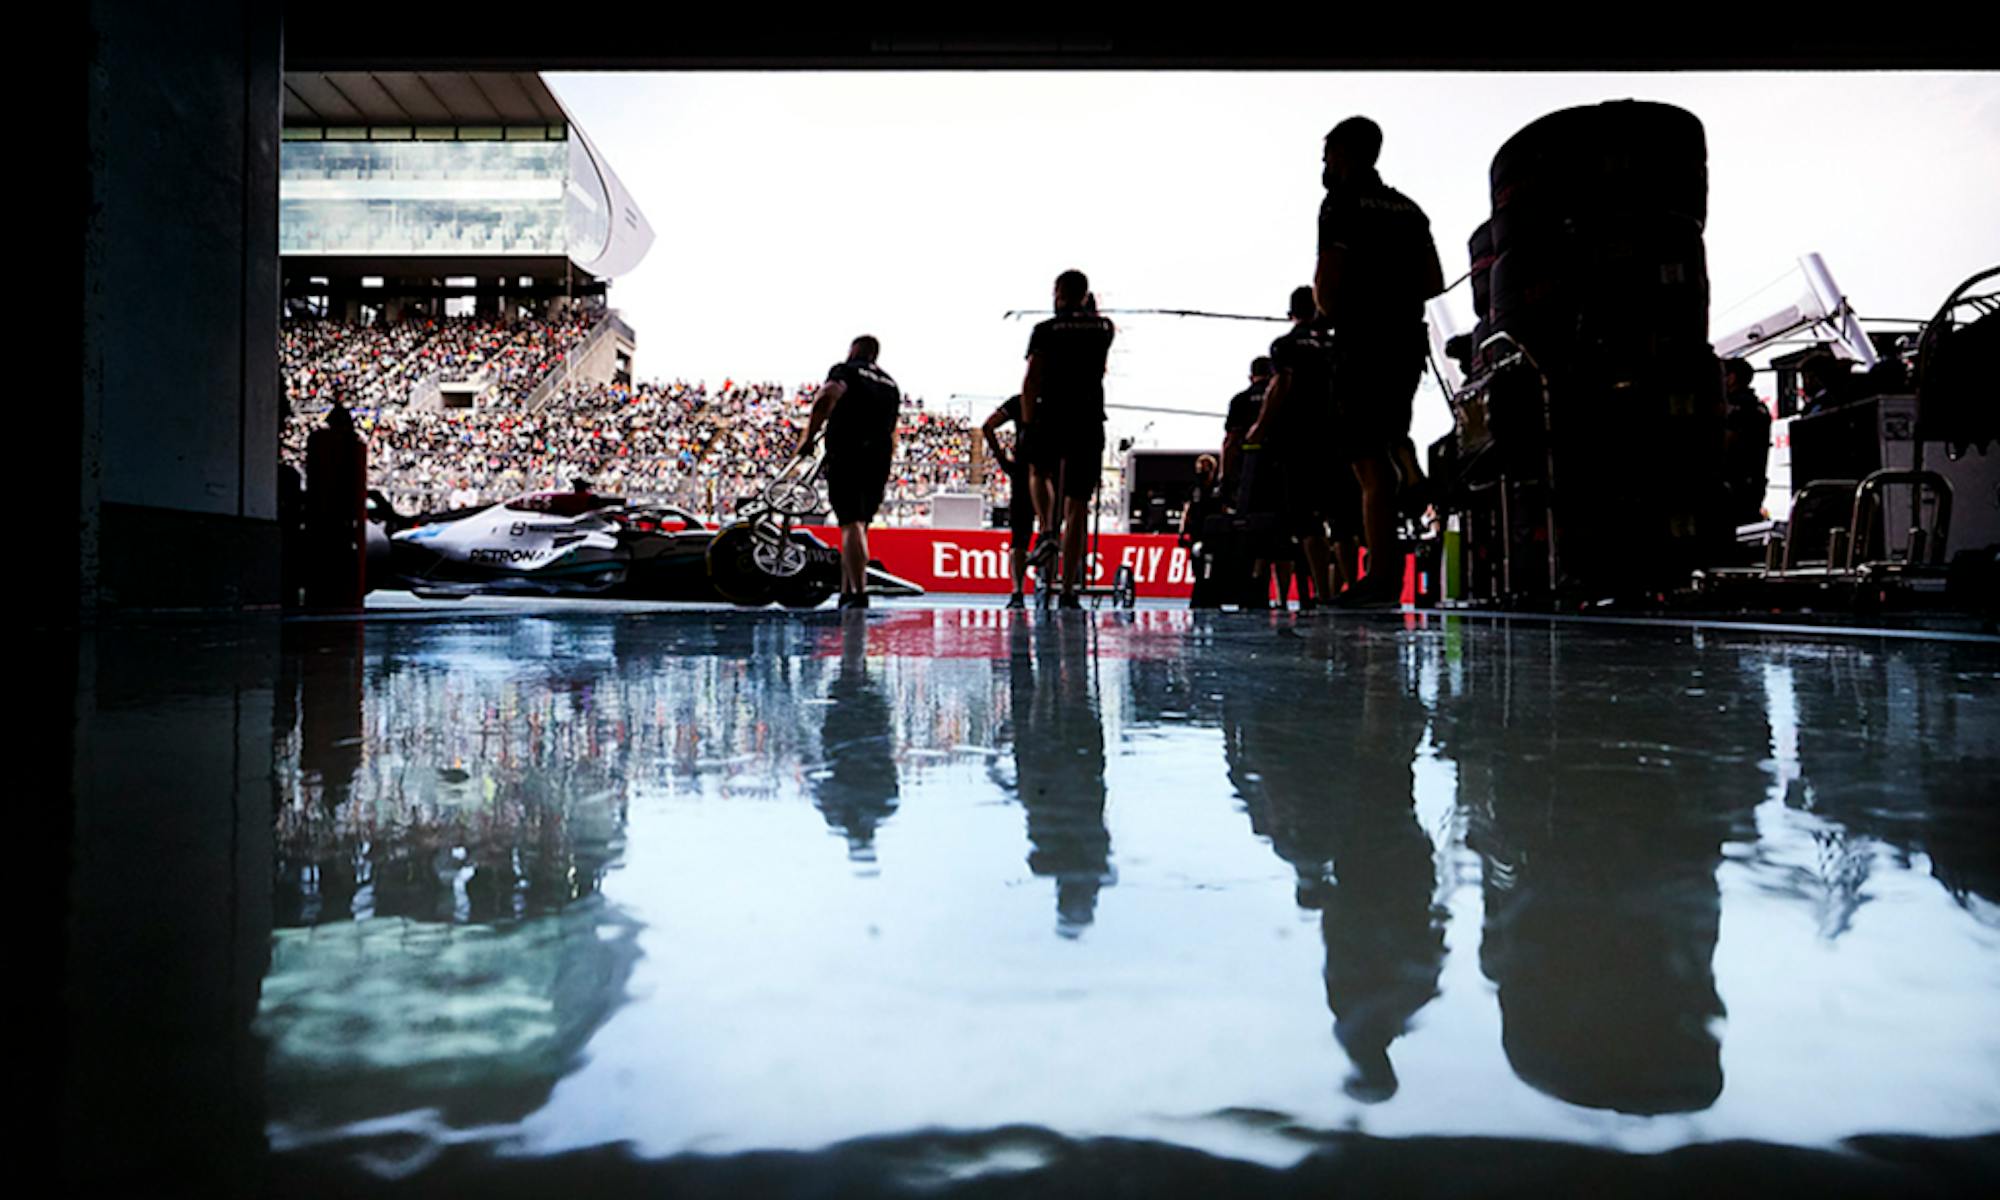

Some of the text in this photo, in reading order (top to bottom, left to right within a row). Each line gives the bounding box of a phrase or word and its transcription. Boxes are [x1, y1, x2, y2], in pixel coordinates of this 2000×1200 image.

[471, 549, 552, 563] PETRONA
[932, 541, 1104, 580] Emis
[1120, 545, 1164, 584] FLY
